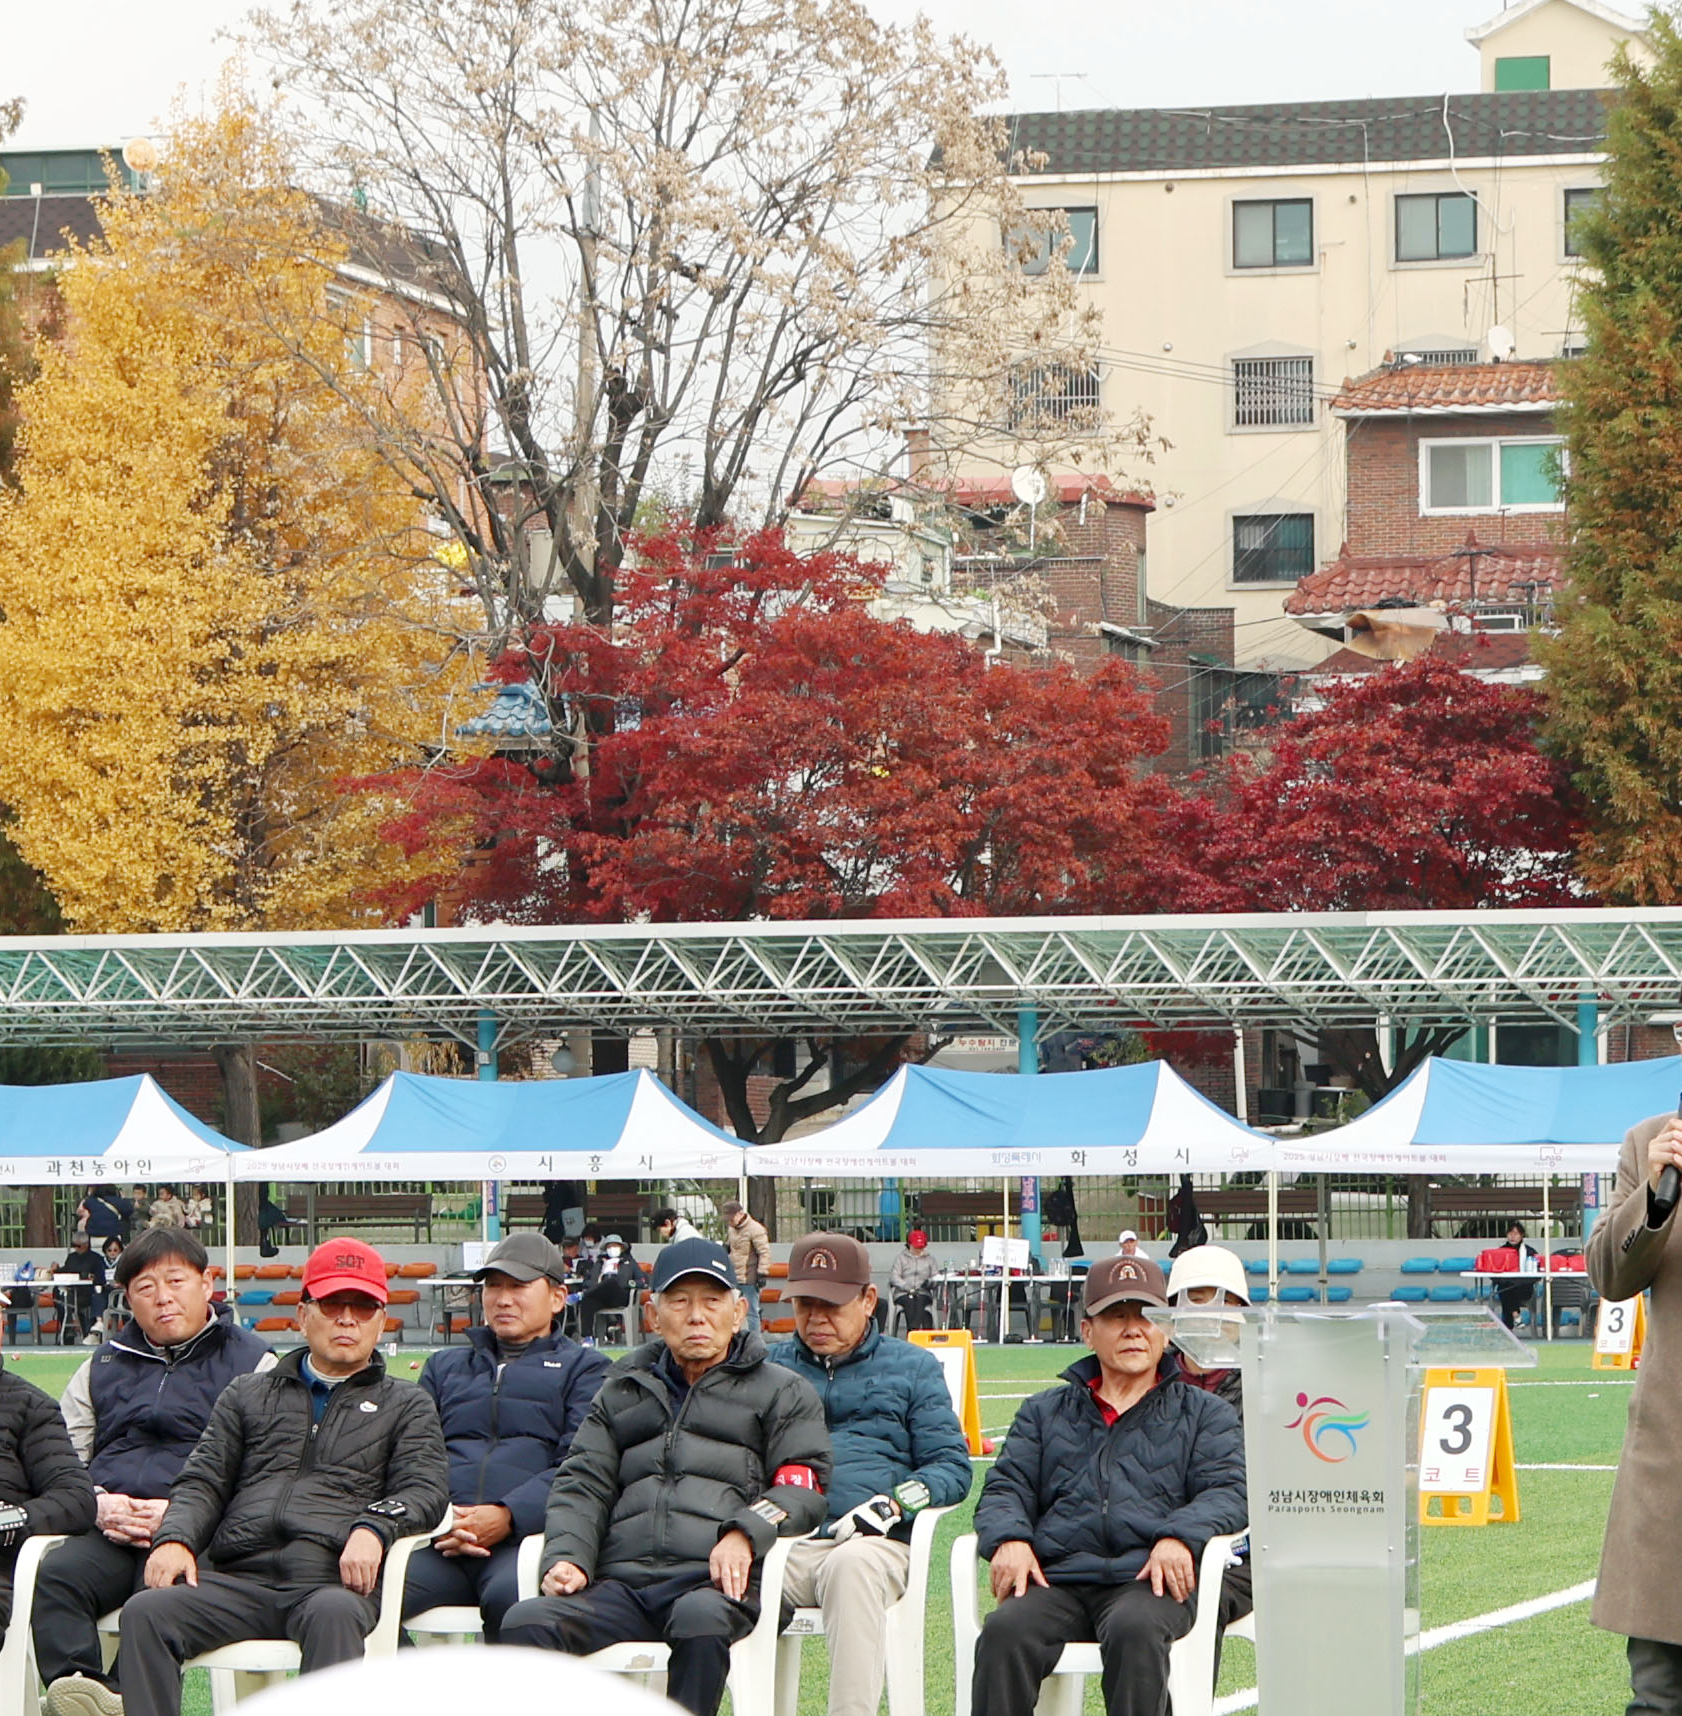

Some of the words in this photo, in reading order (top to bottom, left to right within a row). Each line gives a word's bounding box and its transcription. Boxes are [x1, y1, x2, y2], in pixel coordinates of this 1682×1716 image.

[46, 1159, 152, 1178] 과천농아인
[1607, 1307, 1625, 1334] 3
[1439, 1403, 1473, 1455] 3
[1268, 1489, 1385, 1505] 성남시장애인체육회
[1268, 1505, 1326, 1514] Parasports
[1330, 1505, 1385, 1515] Seongnam
